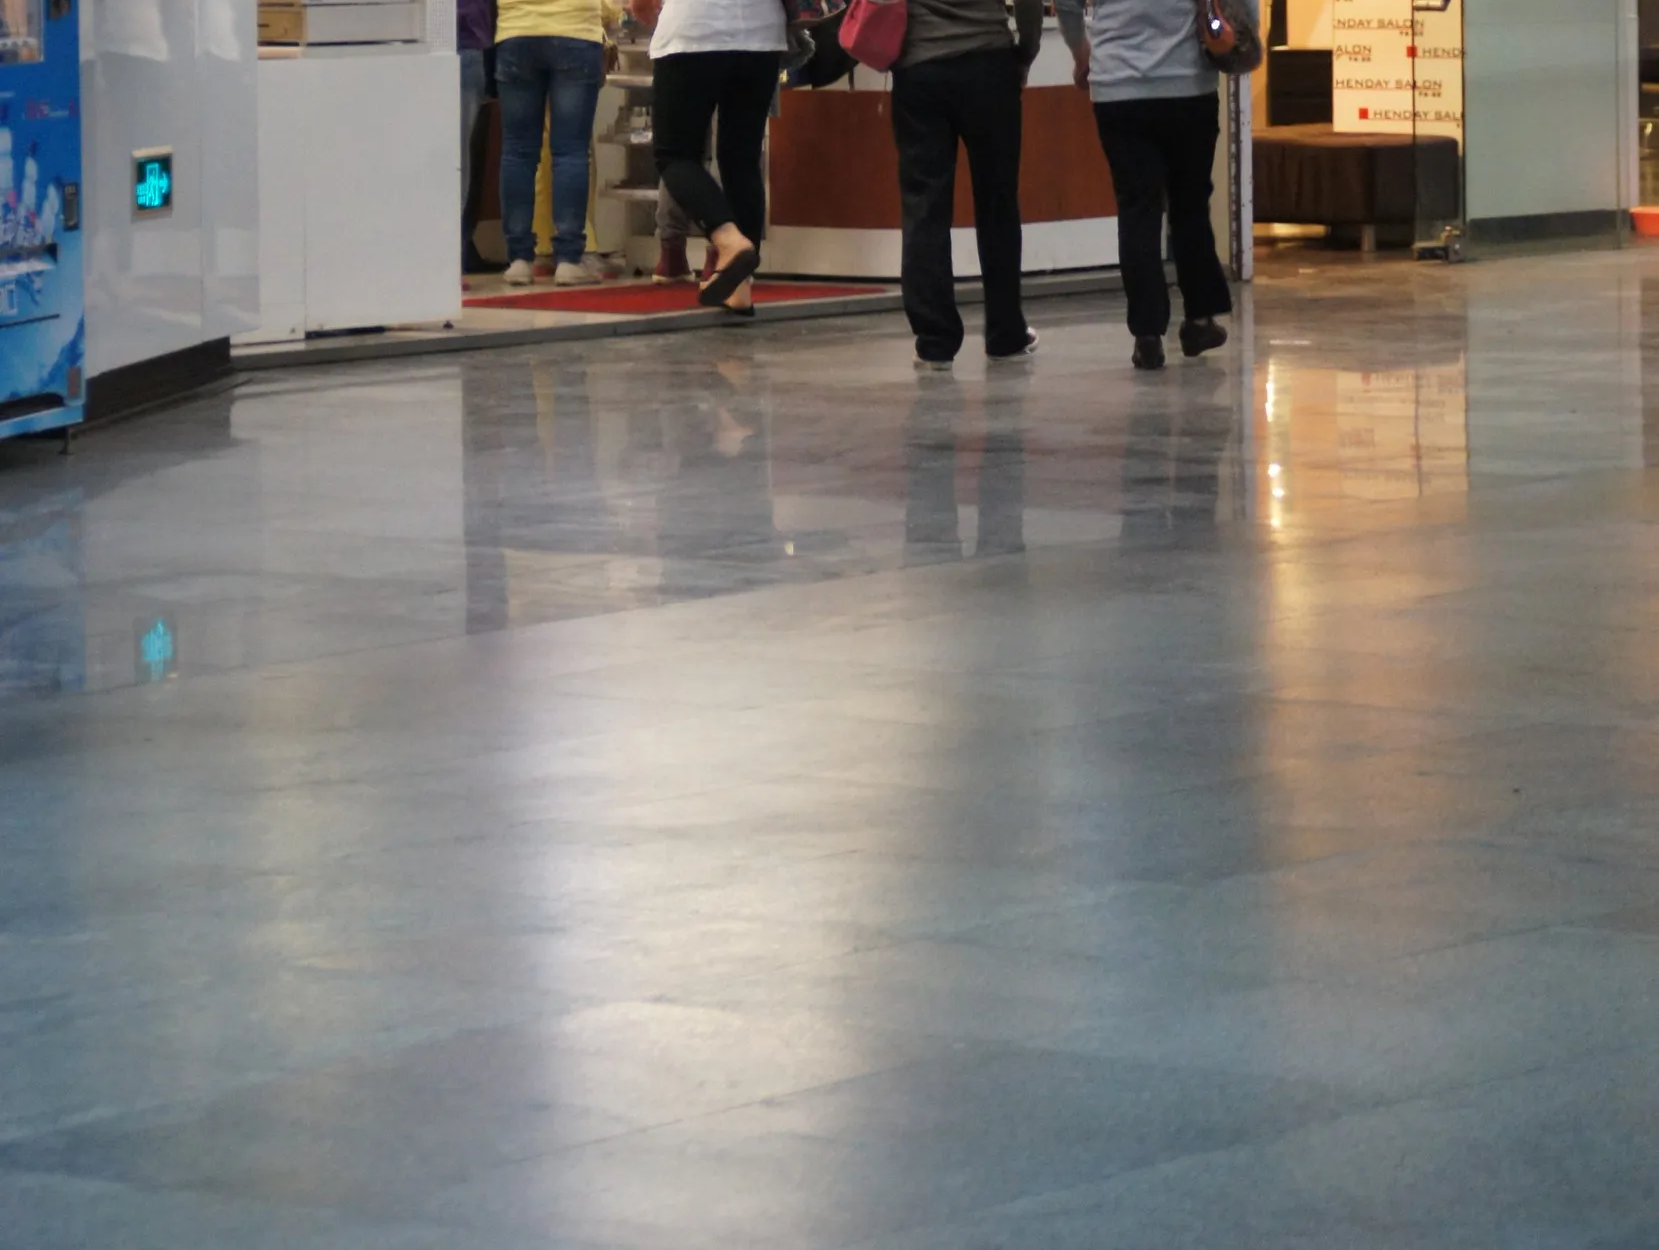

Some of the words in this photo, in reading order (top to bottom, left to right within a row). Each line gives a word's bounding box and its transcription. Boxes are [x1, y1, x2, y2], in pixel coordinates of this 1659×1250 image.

[1377, 18, 1424, 29] SALON
[1335, 78, 1391, 89] HENDAY
[1395, 78, 1443, 90] SALON
[1373, 110, 1429, 121] HENDAY
